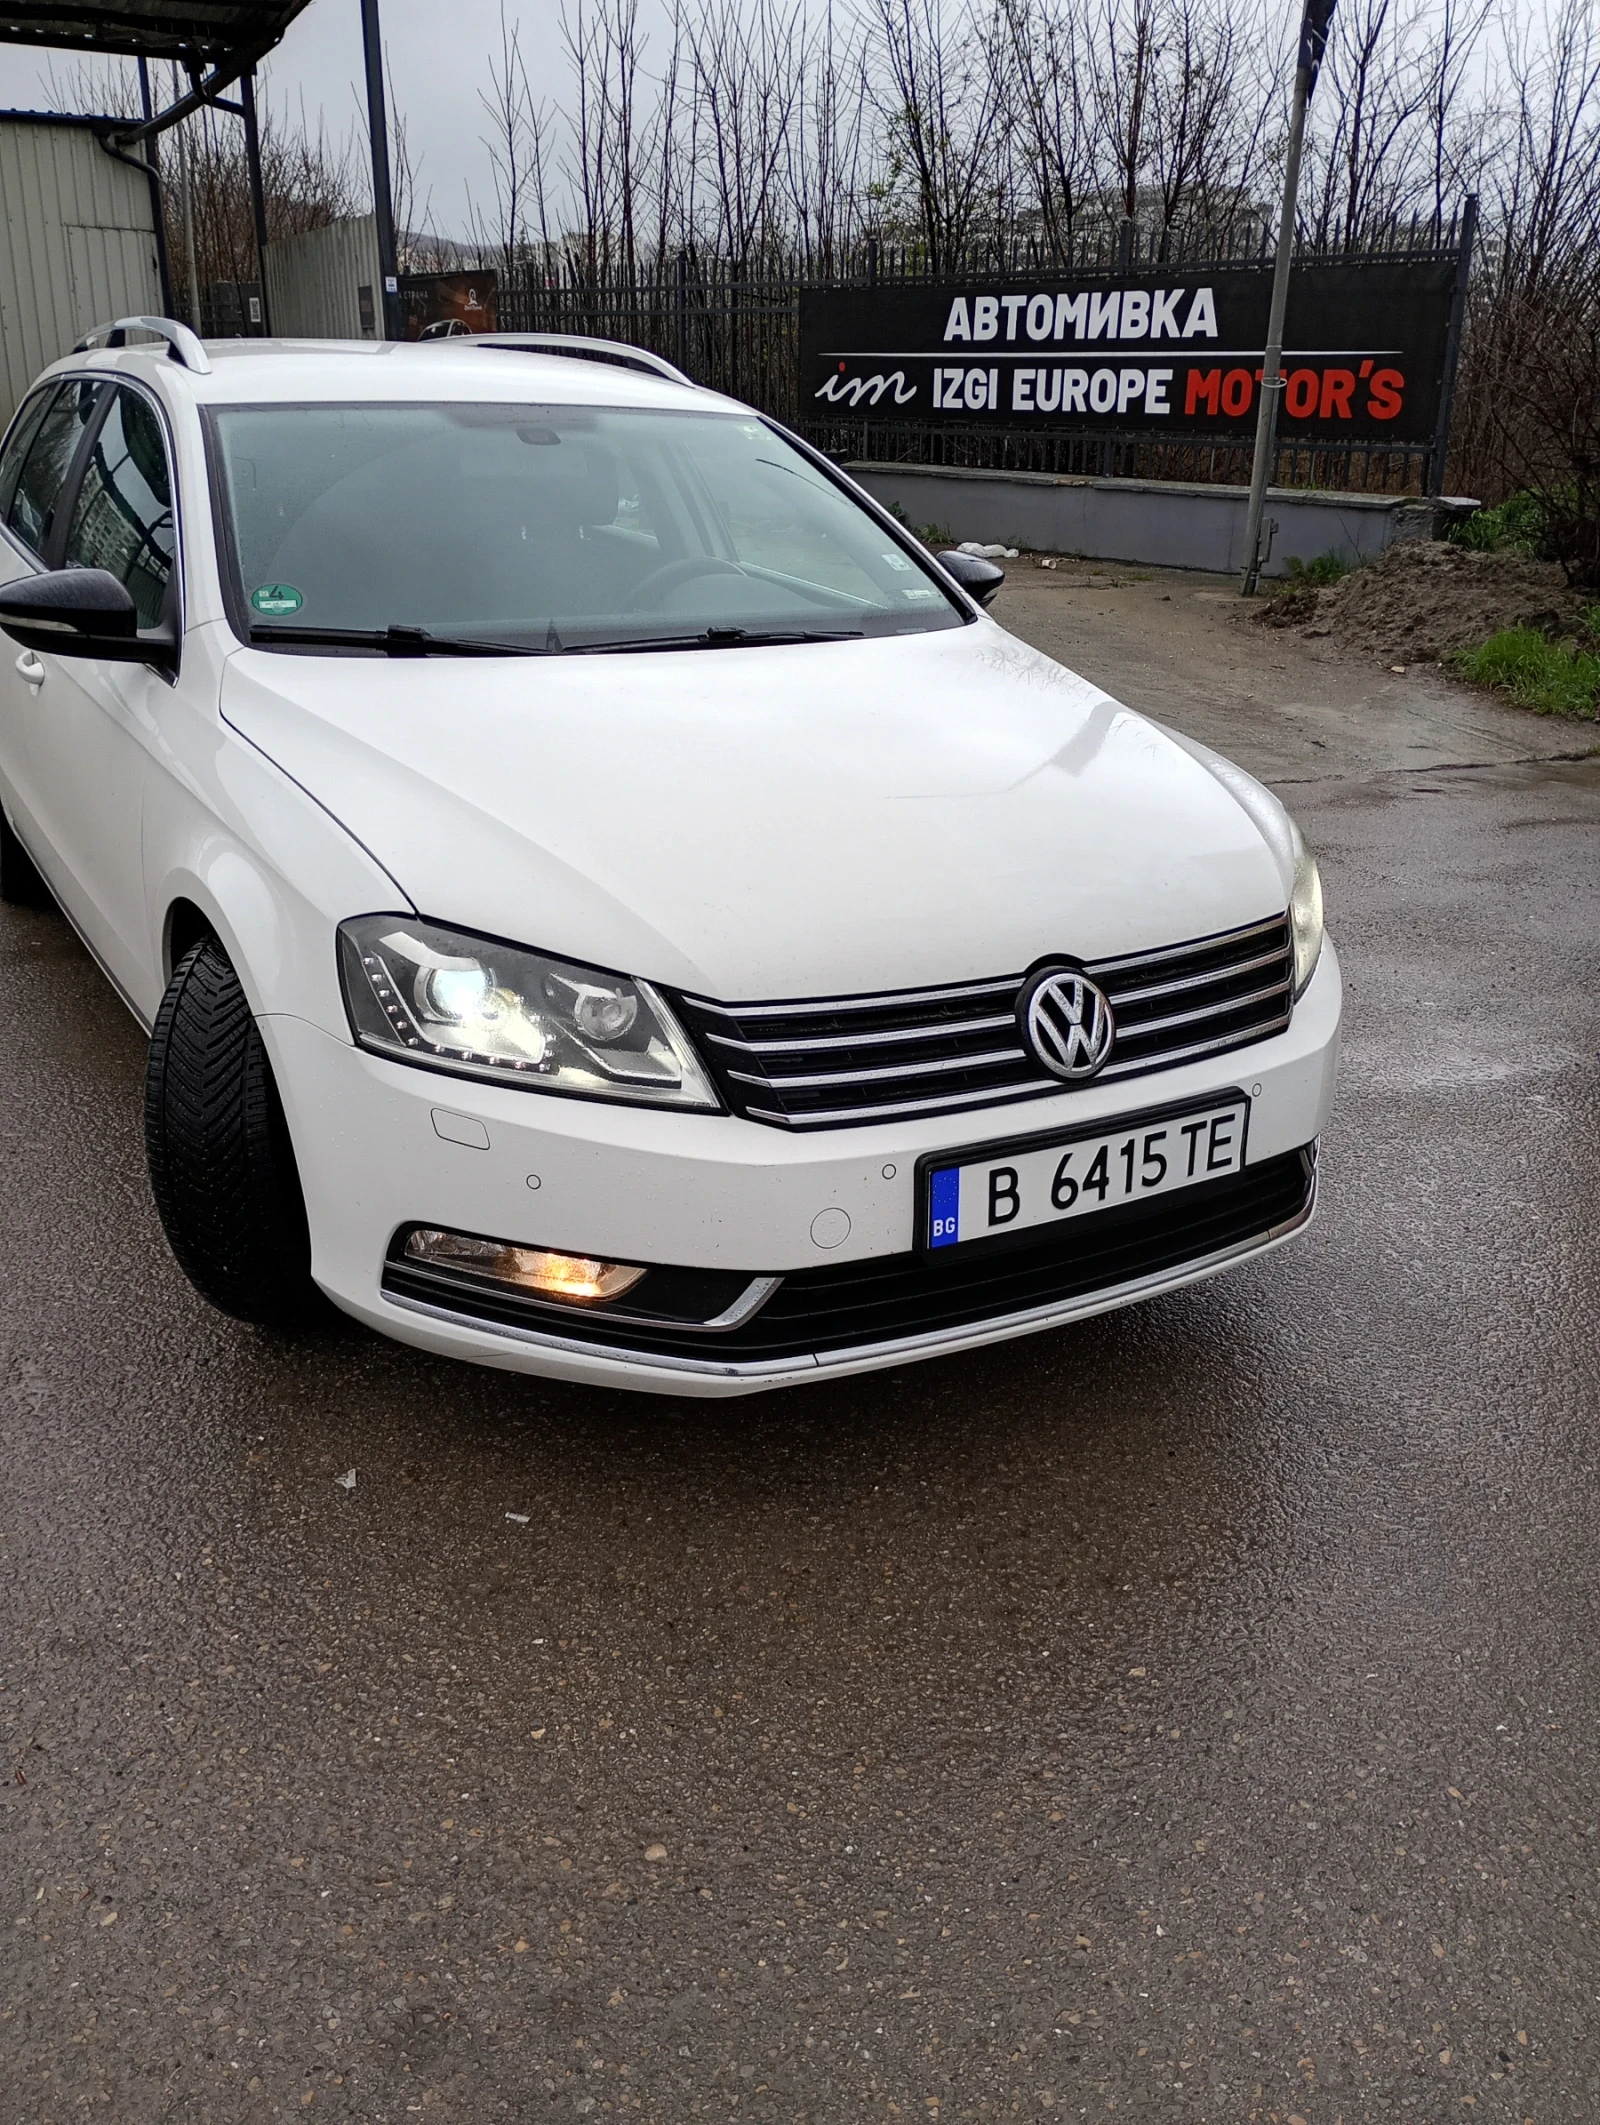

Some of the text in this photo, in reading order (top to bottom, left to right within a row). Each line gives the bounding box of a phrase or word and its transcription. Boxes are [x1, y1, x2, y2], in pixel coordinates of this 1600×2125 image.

[943, 288, 1218, 341] АВТОМИВКА
[932, 367, 998, 411] IZGI
[1012, 369, 1173, 415] EUROPE
[269, 585, 284, 600] 4
[988, 1113, 1236, 1227] B 6415 TE
[933, 1216, 956, 1238] BG
